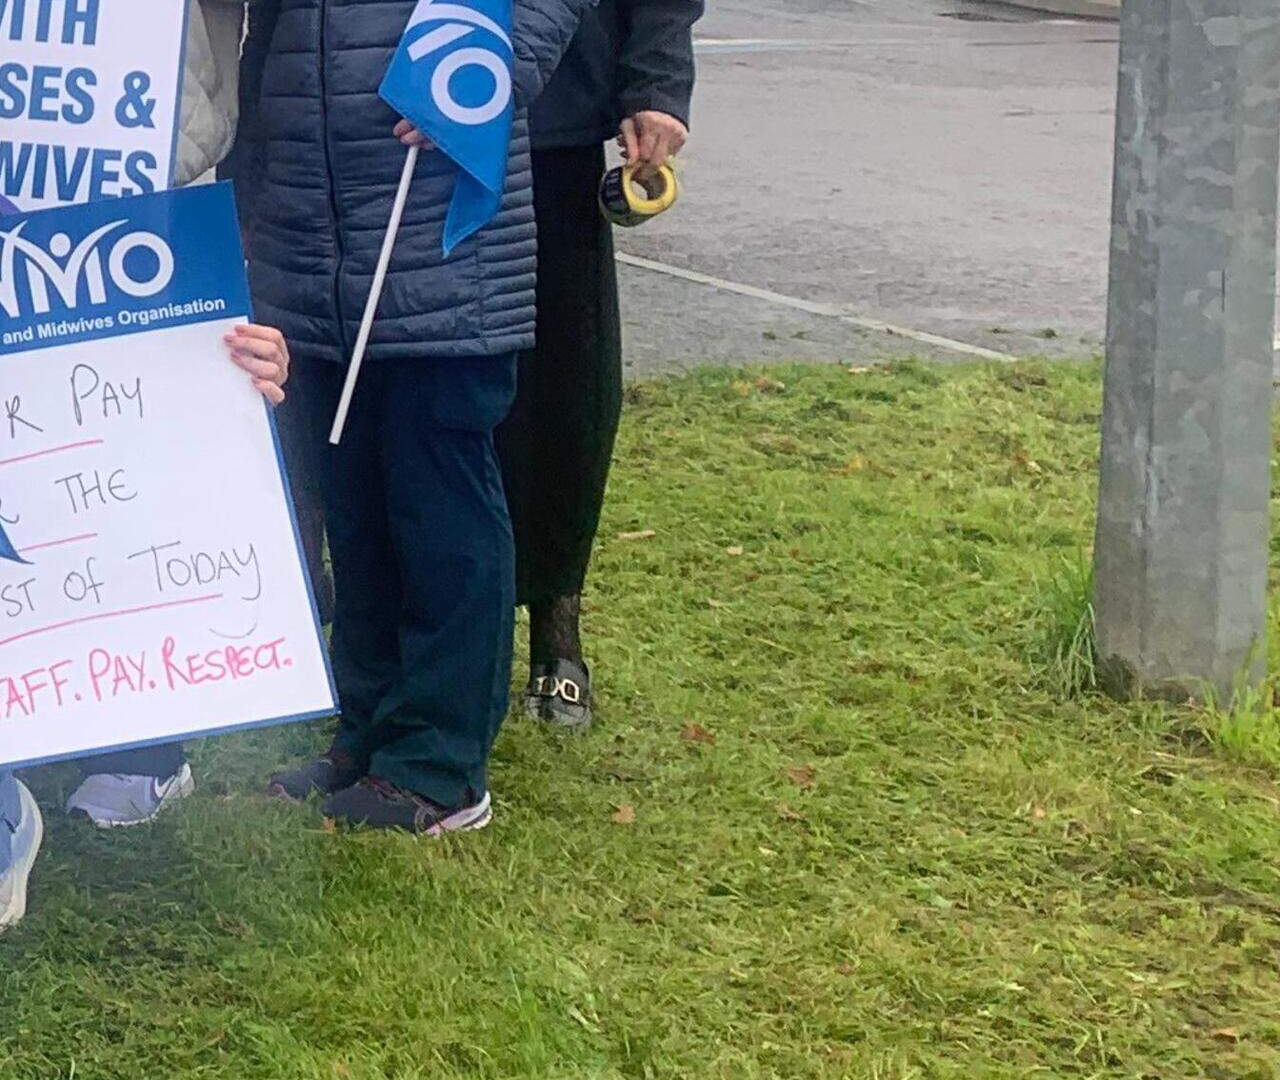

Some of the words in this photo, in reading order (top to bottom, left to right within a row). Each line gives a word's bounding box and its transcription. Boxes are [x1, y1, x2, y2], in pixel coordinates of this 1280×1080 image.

[115, 70, 156, 129] &
[3, 325, 34, 346] and
[38, 314, 114, 340] Midwives
[117, 296, 225, 327] Organisation
[70, 363, 144, 426] PAY
[54, 468, 138, 514] THE
[128, 541, 261, 601] TODAY
